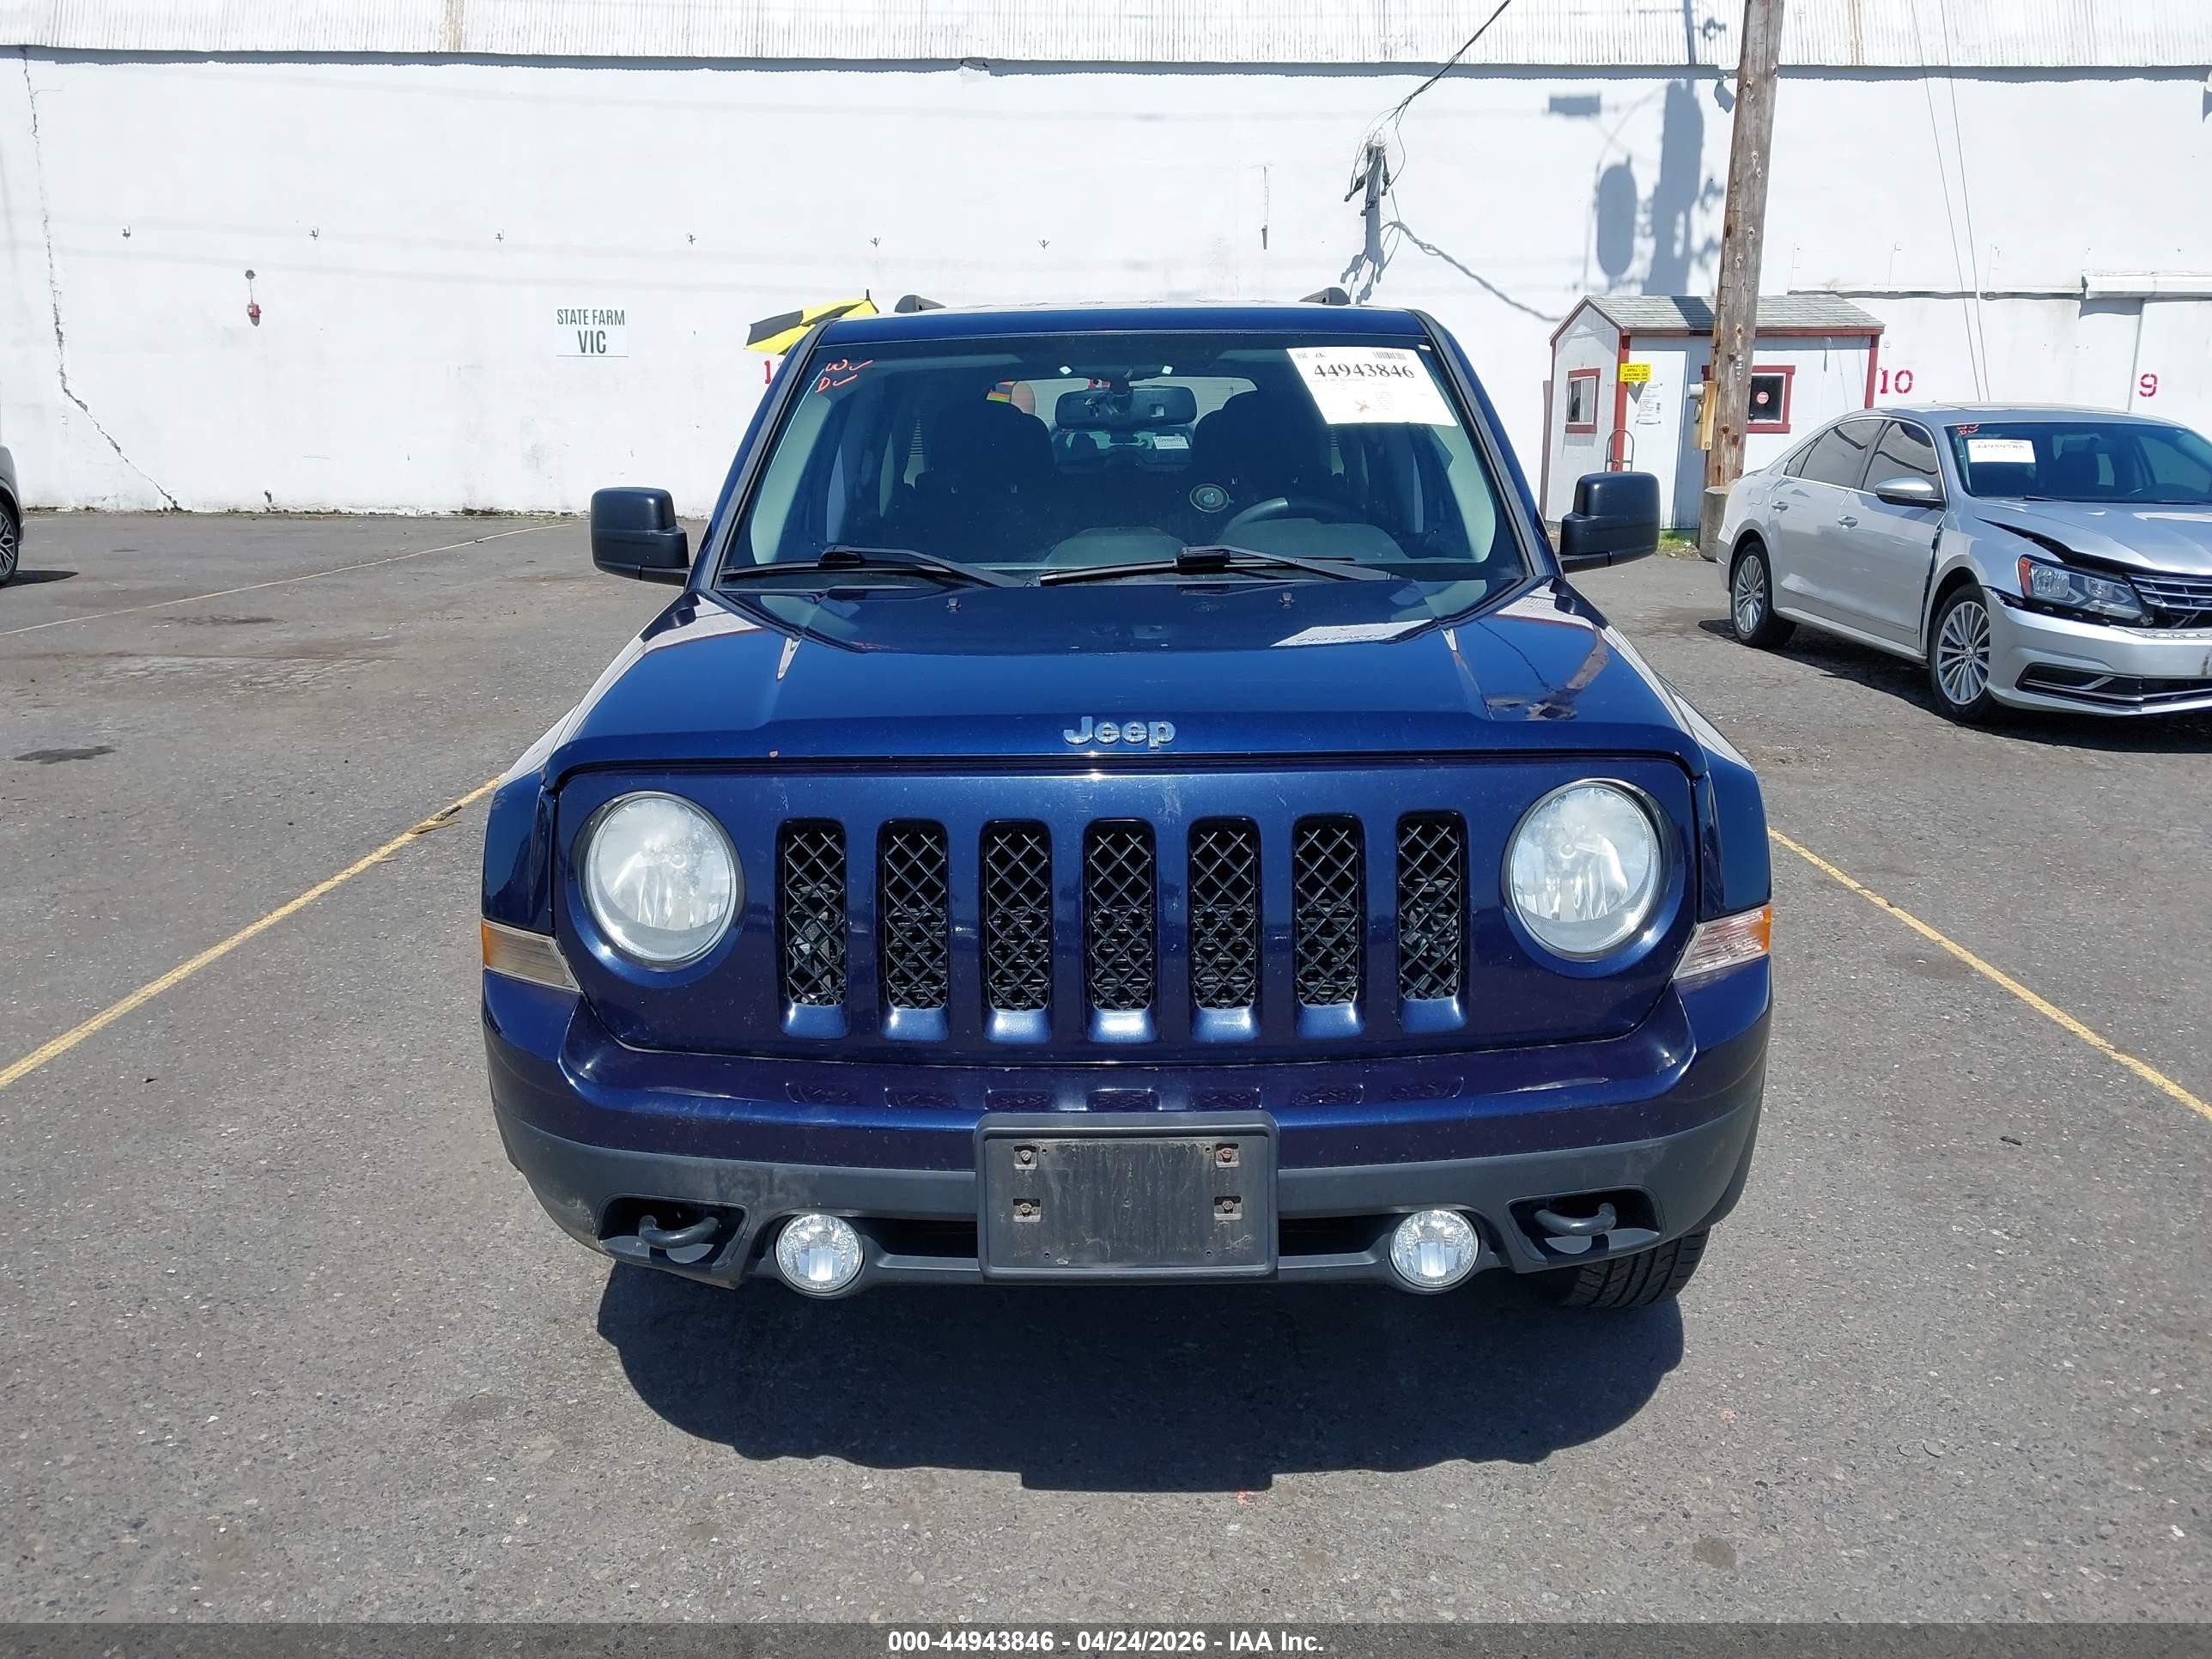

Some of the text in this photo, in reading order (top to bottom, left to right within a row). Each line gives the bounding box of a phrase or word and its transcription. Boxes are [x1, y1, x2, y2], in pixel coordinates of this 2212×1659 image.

[556, 308, 625, 325] STATE FARM
[577, 330, 606, 354] VIC
[1314, 363, 1415, 379] 44943846
[1880, 369, 1914, 394] 10
[2139, 373, 2158, 398] 9
[1063, 715, 1176, 750] Jeep
